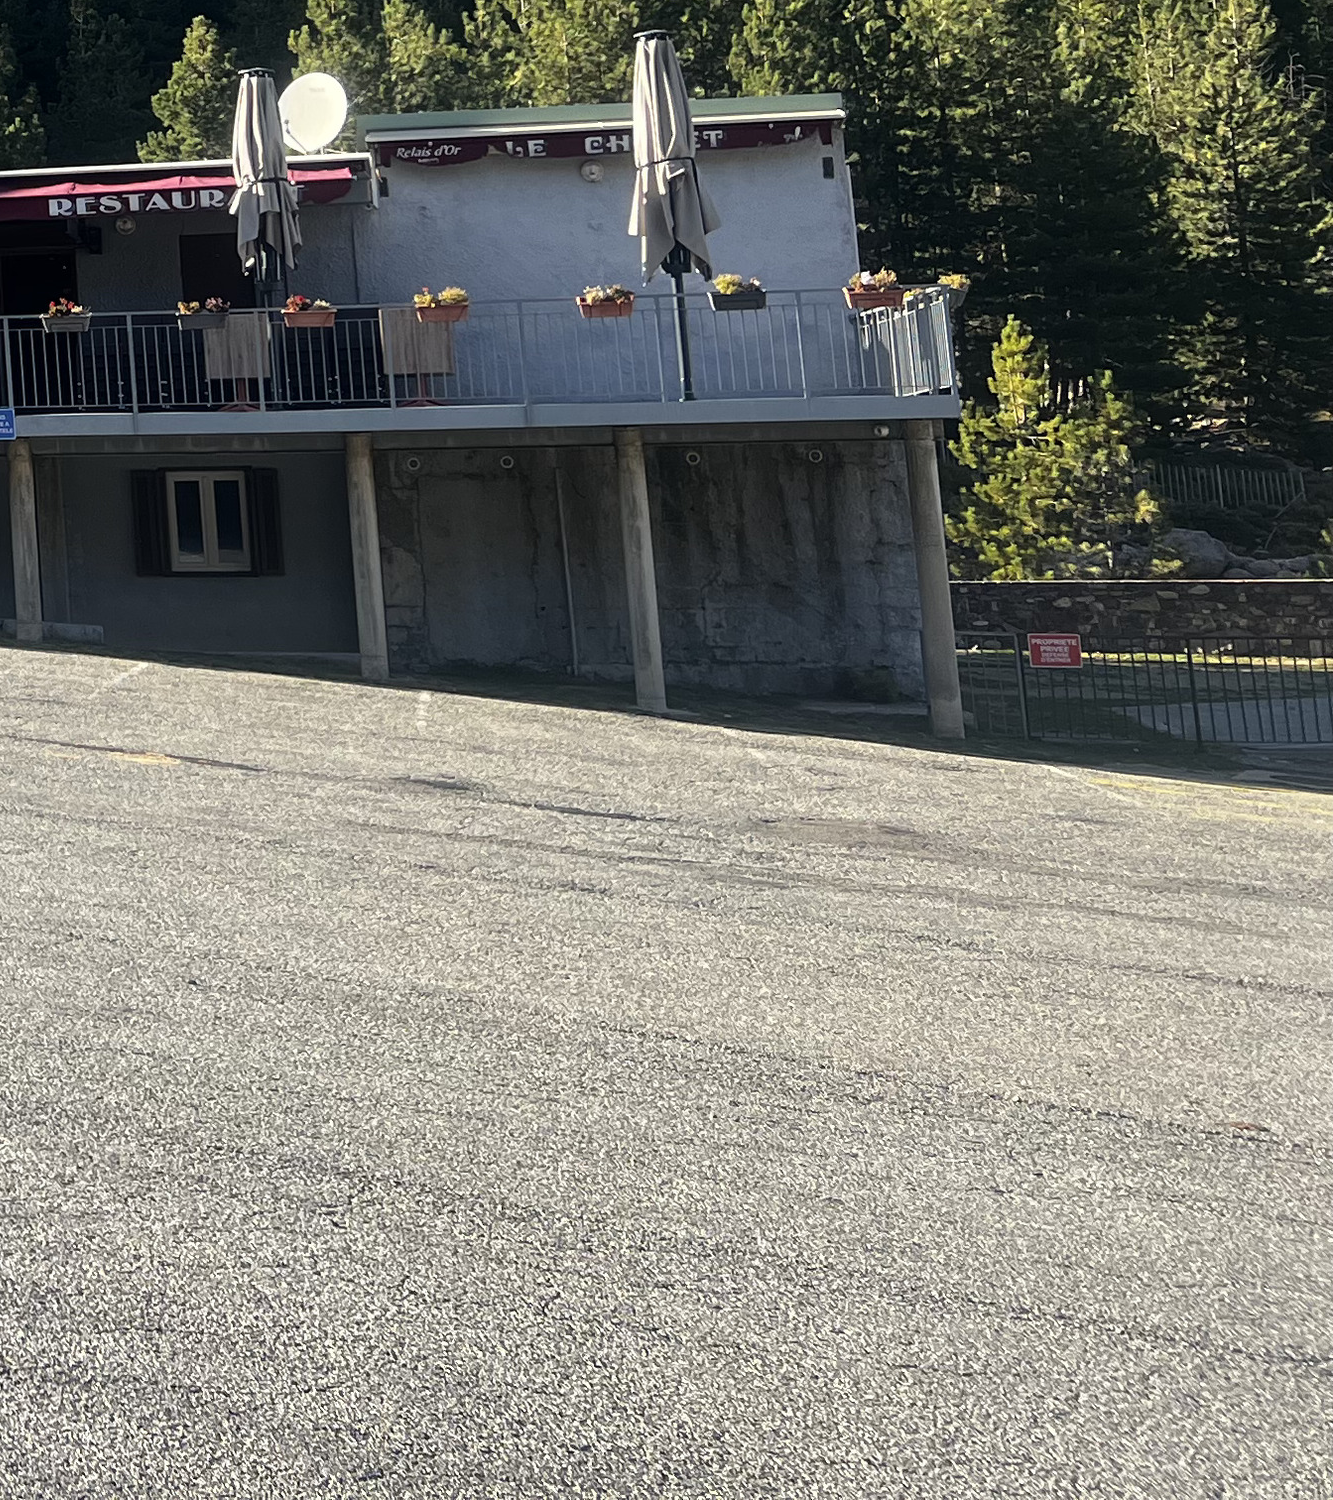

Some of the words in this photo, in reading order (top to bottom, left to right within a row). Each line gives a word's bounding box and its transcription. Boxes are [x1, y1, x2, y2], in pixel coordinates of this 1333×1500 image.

[396, 145, 432, 159] Relais
[434, 143, 462, 157] d'Or
[584, 130, 724, 154] CHT
[48, 185, 304, 217] RESTAUR
